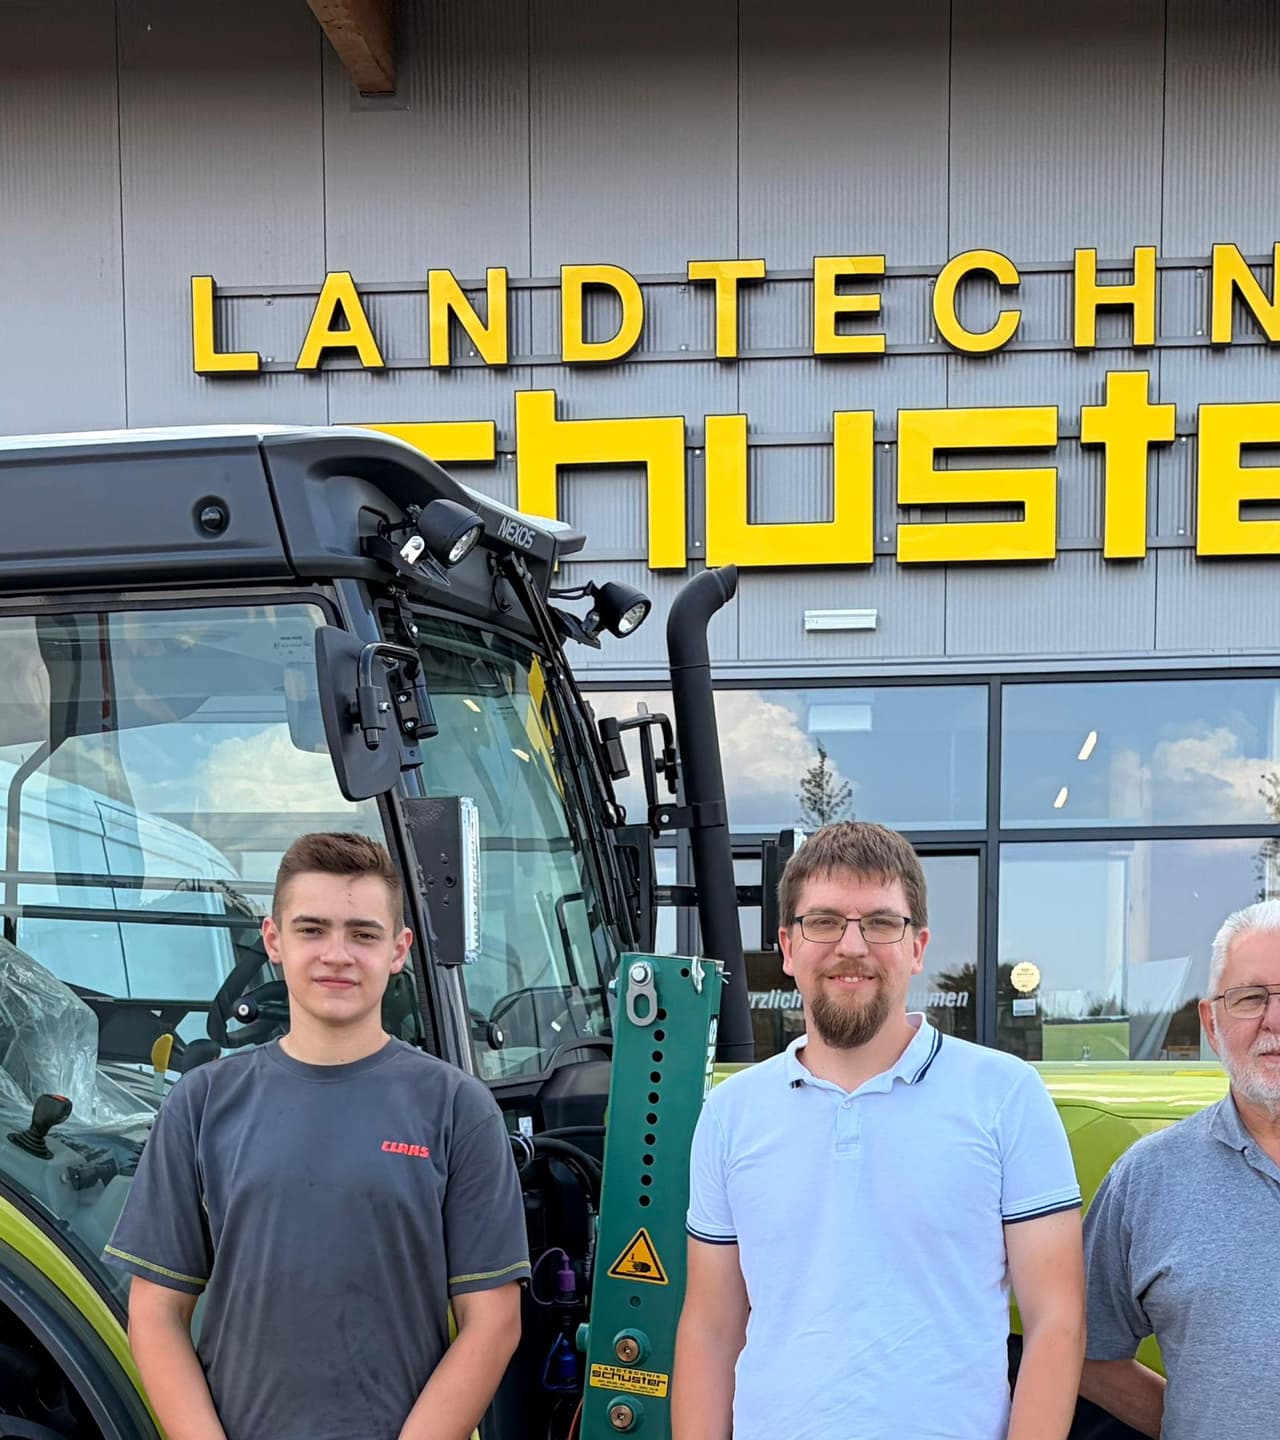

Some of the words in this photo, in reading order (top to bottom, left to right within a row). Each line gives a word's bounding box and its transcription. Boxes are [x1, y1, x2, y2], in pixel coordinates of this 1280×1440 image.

[497, 517, 536, 549] NEXOS
[380, 1139, 431, 1159] CLAAS
[591, 1370, 666, 1387] schuster
